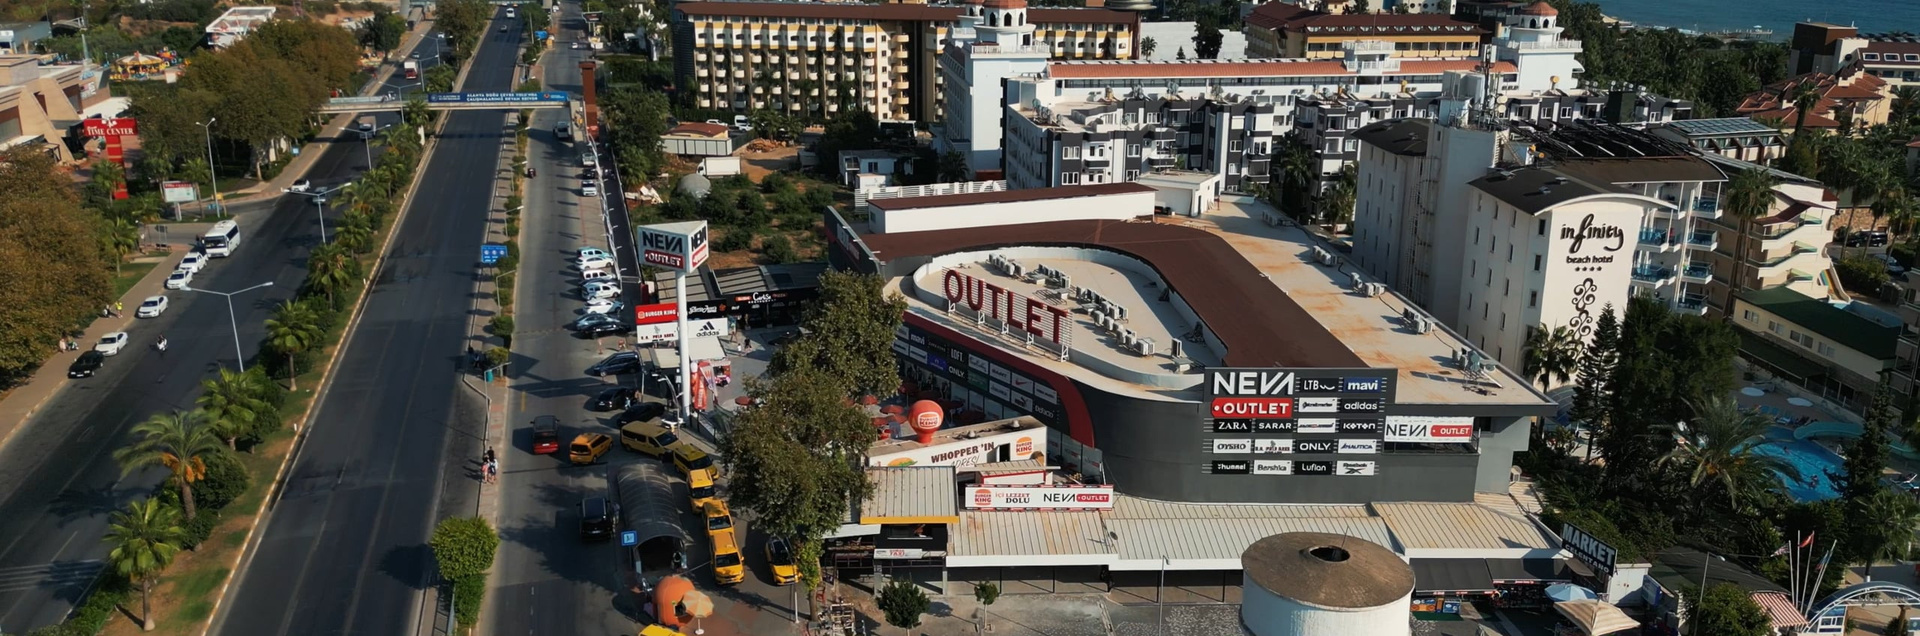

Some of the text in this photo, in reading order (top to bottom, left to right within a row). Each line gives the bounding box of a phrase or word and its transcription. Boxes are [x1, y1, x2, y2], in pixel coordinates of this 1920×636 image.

[87, 128, 105, 136] TIME
[642, 231, 683, 253] NEVA
[648, 252, 682, 266] OUTLET
[1566, 255, 1613, 264] beach hotel
[945, 269, 1069, 344] OUTLET
[948, 365, 964, 377] ONLY
[1213, 371, 1295, 395] NEVA
[1303, 380, 1319, 390] LTB
[1347, 379, 1379, 391] mavi
[1222, 402, 1290, 415] OUTLET
[1344, 402, 1378, 410] adidas
[1218, 421, 1248, 430] ZARA
[1258, 422, 1292, 430] SARAR
[1385, 424, 1470, 437] NEVA OUTLET
[1300, 442, 1331, 451] ONLY
[931, 445, 979, 463] WHOPPER
[1043, 493, 1076, 502] NEVA
[1563, 523, 1615, 566] MARKET
